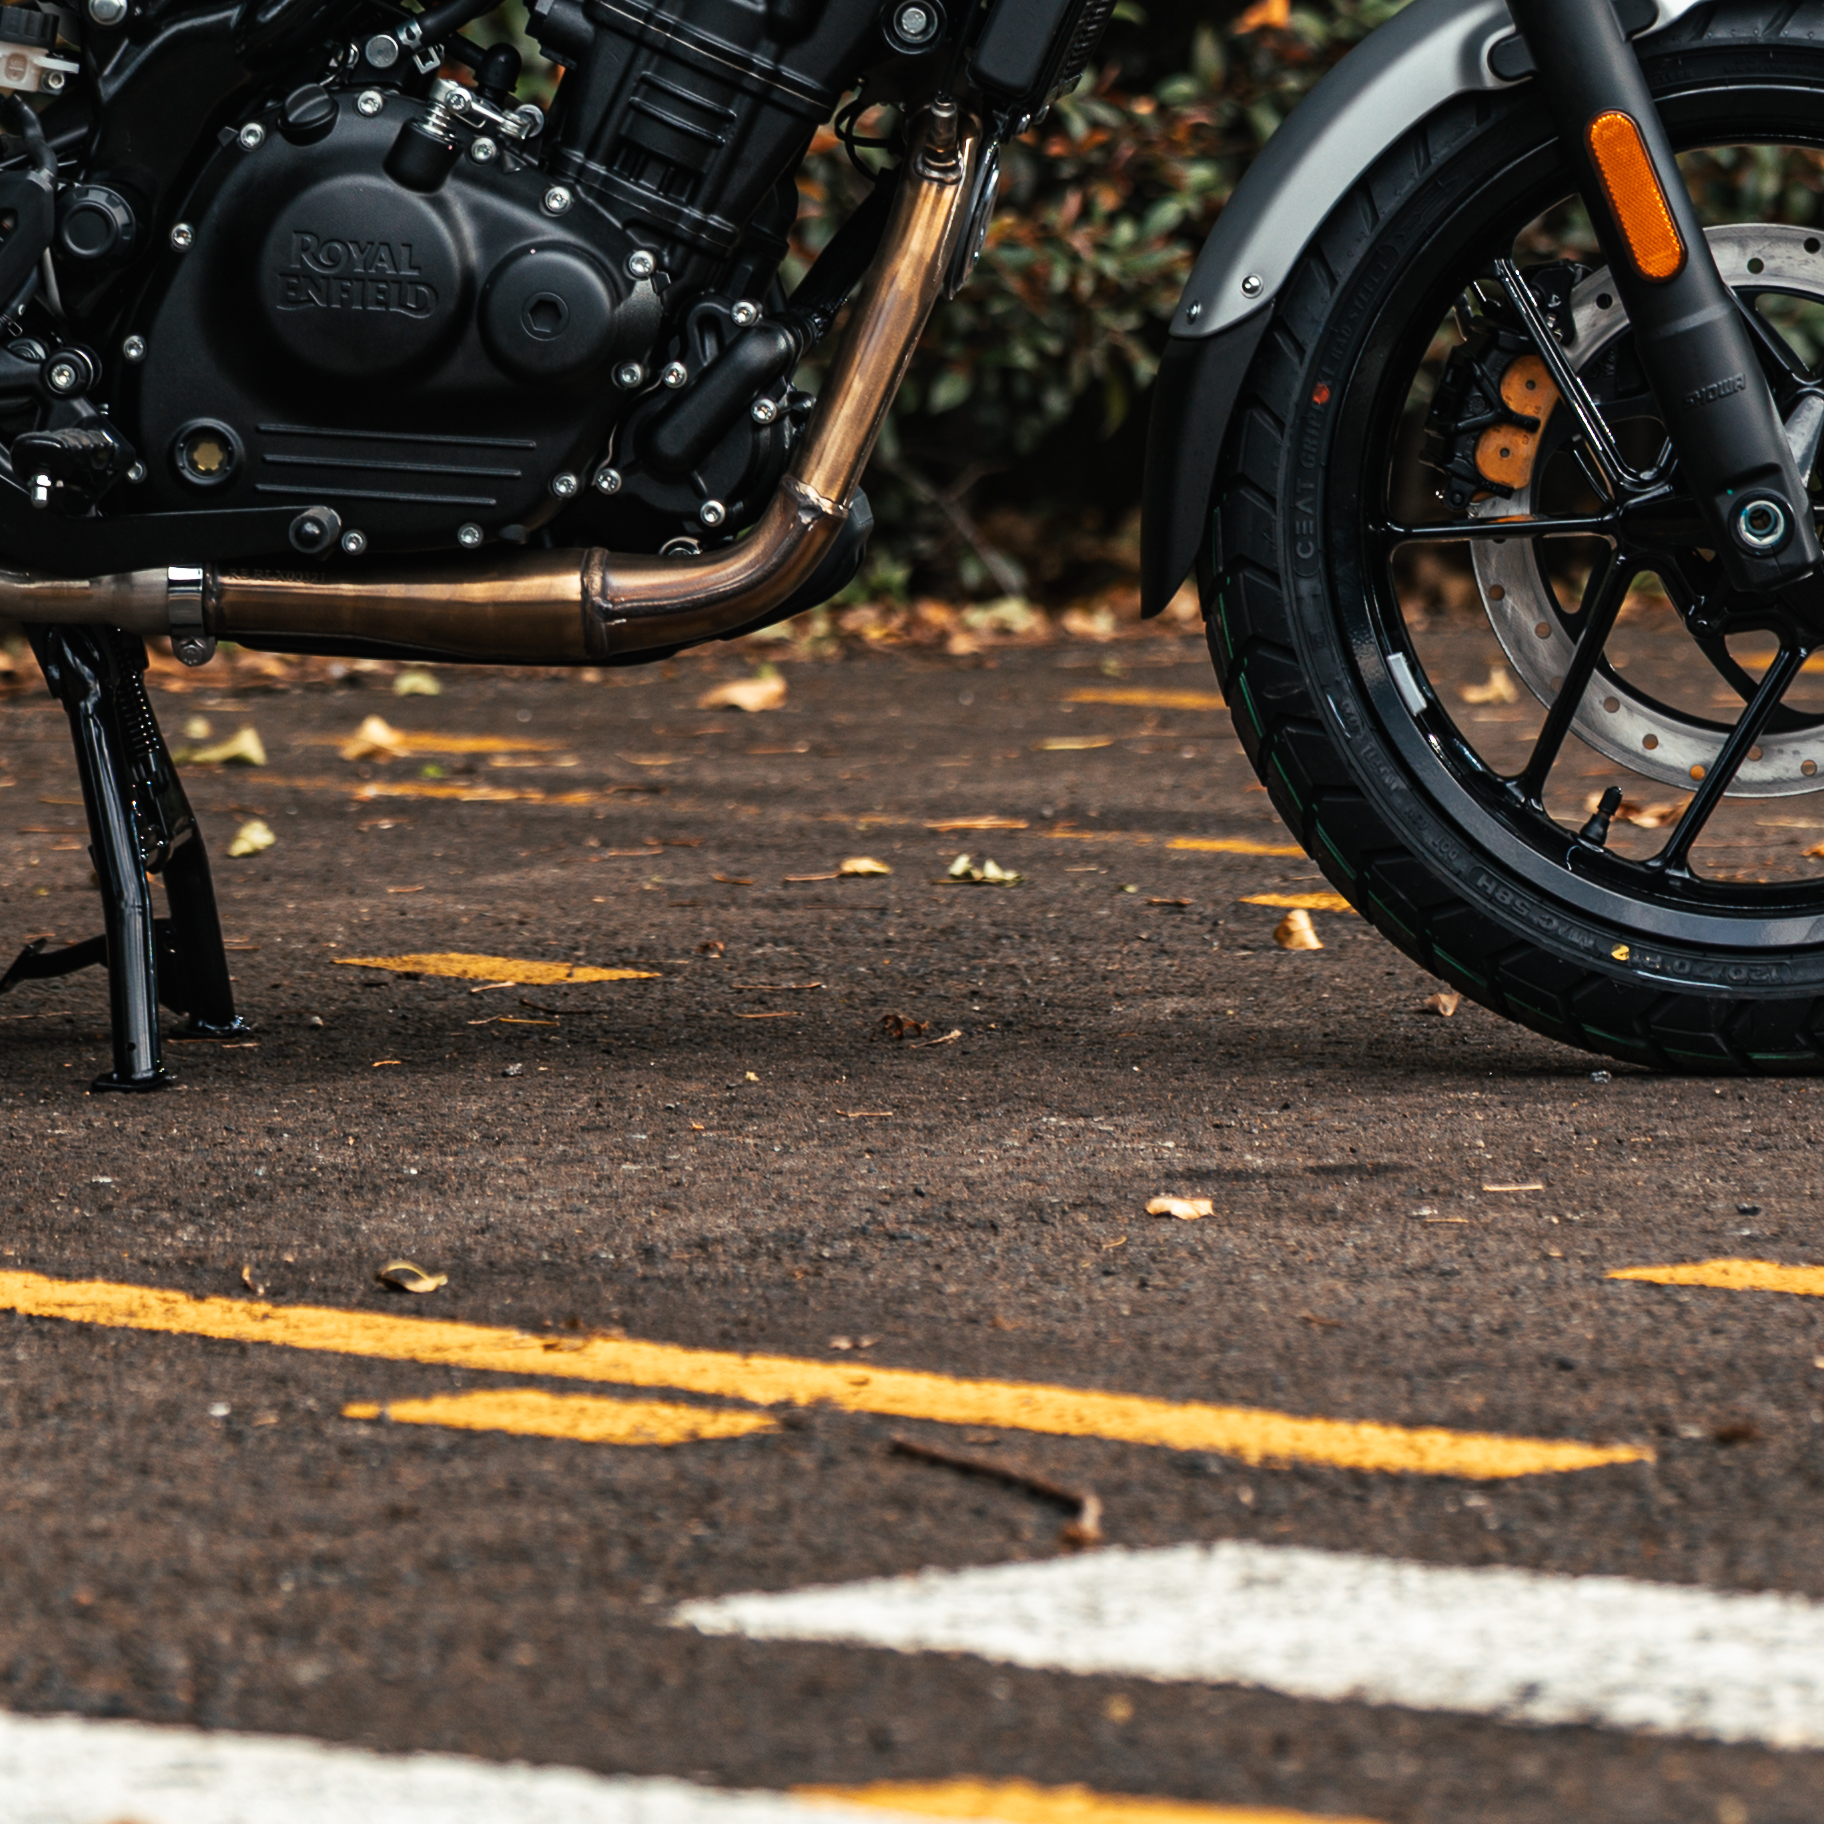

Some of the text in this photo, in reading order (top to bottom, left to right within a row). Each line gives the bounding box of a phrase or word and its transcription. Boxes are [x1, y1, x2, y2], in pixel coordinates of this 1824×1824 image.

[290, 230, 422, 277] ROYAL
[277, 273, 438, 319] ENFIELD
[1681, 372, 1746, 412] SHOWA
[1294, 478, 1316, 559] CEAT
[1473, 870, 1535, 919] 58H
